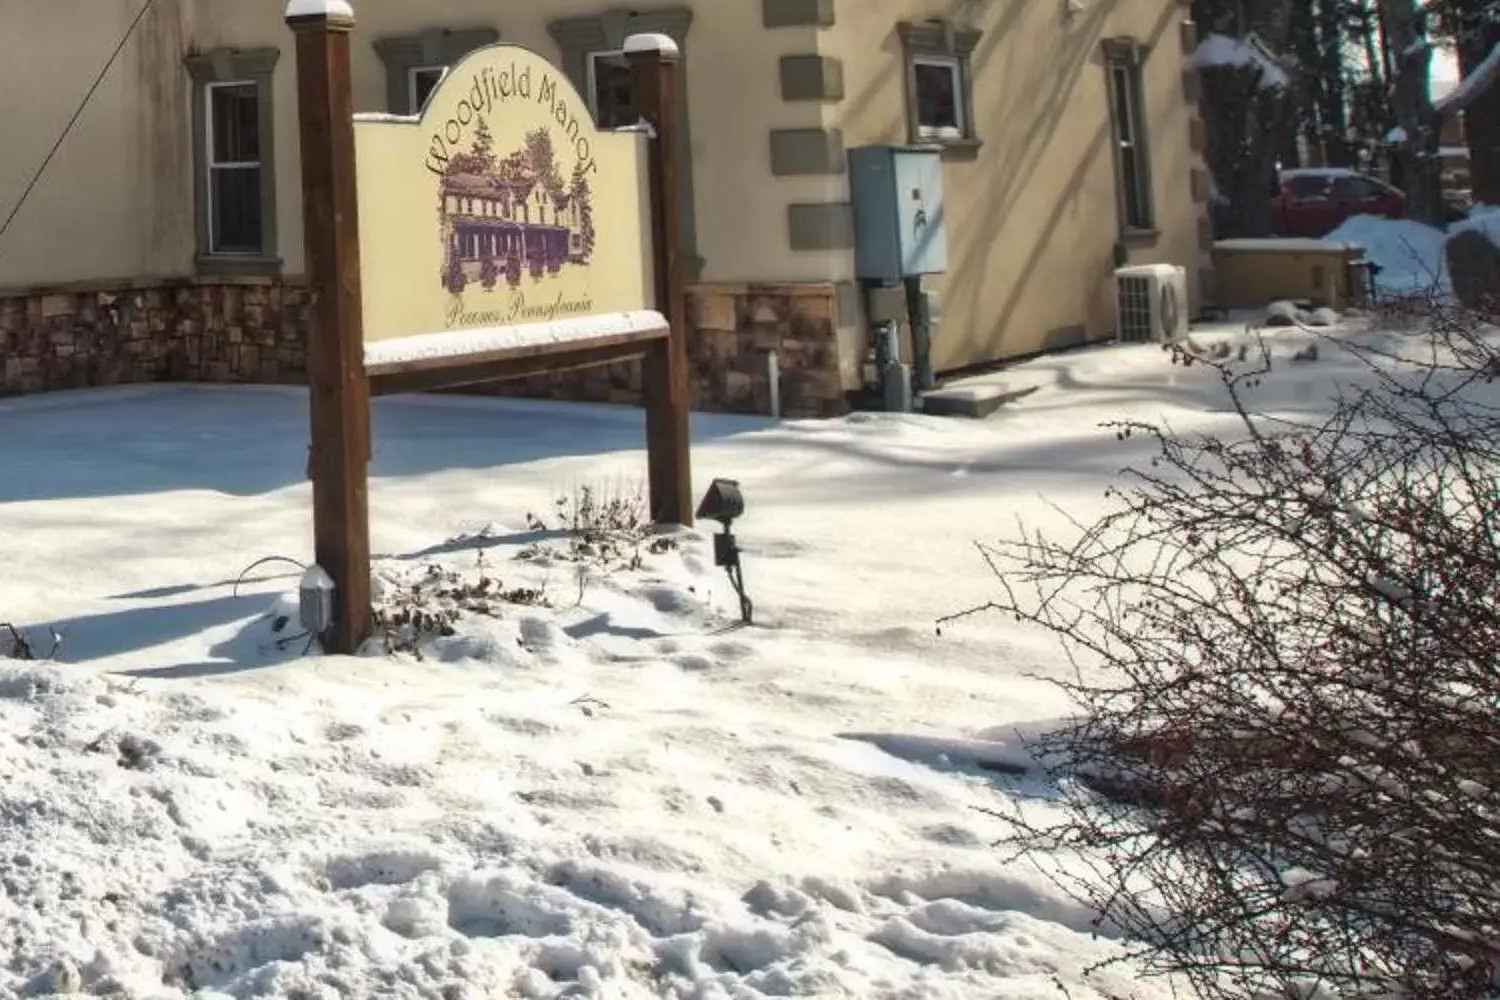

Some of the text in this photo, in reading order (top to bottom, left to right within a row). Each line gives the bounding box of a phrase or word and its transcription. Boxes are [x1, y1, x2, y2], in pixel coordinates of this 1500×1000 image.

[426, 61, 597, 175] Woodfield Manor
[507, 291, 593, 320] Pennsylvania
